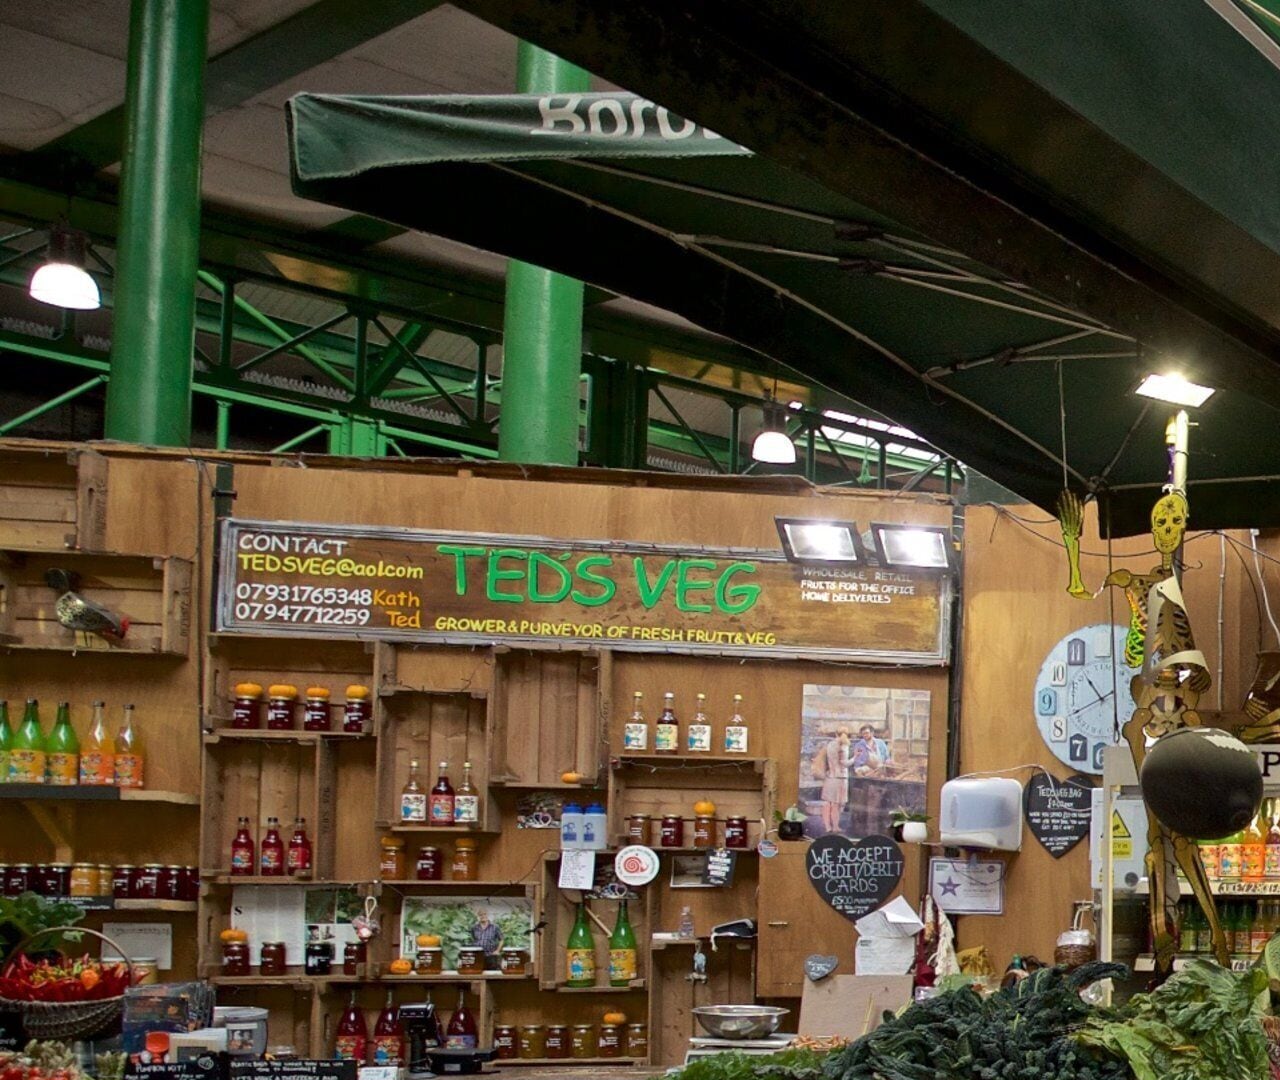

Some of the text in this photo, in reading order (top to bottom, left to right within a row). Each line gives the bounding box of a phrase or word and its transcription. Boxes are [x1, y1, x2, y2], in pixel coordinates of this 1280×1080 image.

[537, 94, 745, 150] Boro
[238, 534, 348, 556] CONTACT
[436, 544, 762, 615] TED'S VEG
[874, 571, 913, 583] RETAIL
[235, 583, 420, 607] 07931765348 Kath
[800, 580, 915, 595] FRUITS FOR THE OFFICE
[801, 592, 892, 604] HOME DELIVERIES
[235, 602, 421, 629] 07947712259 Ted
[606, 625, 629, 638] OF
[632, 625, 683, 642] FRESH
[746, 631, 776, 645] VEG
[1052, 664, 1064, 682] 10
[1042, 692, 1052, 711] 9
[1053, 719, 1063, 738] 8
[1072, 738, 1083, 758] 7
[810, 846, 893, 864] WE ACCEPT
[825, 877, 879, 895] CARDS
